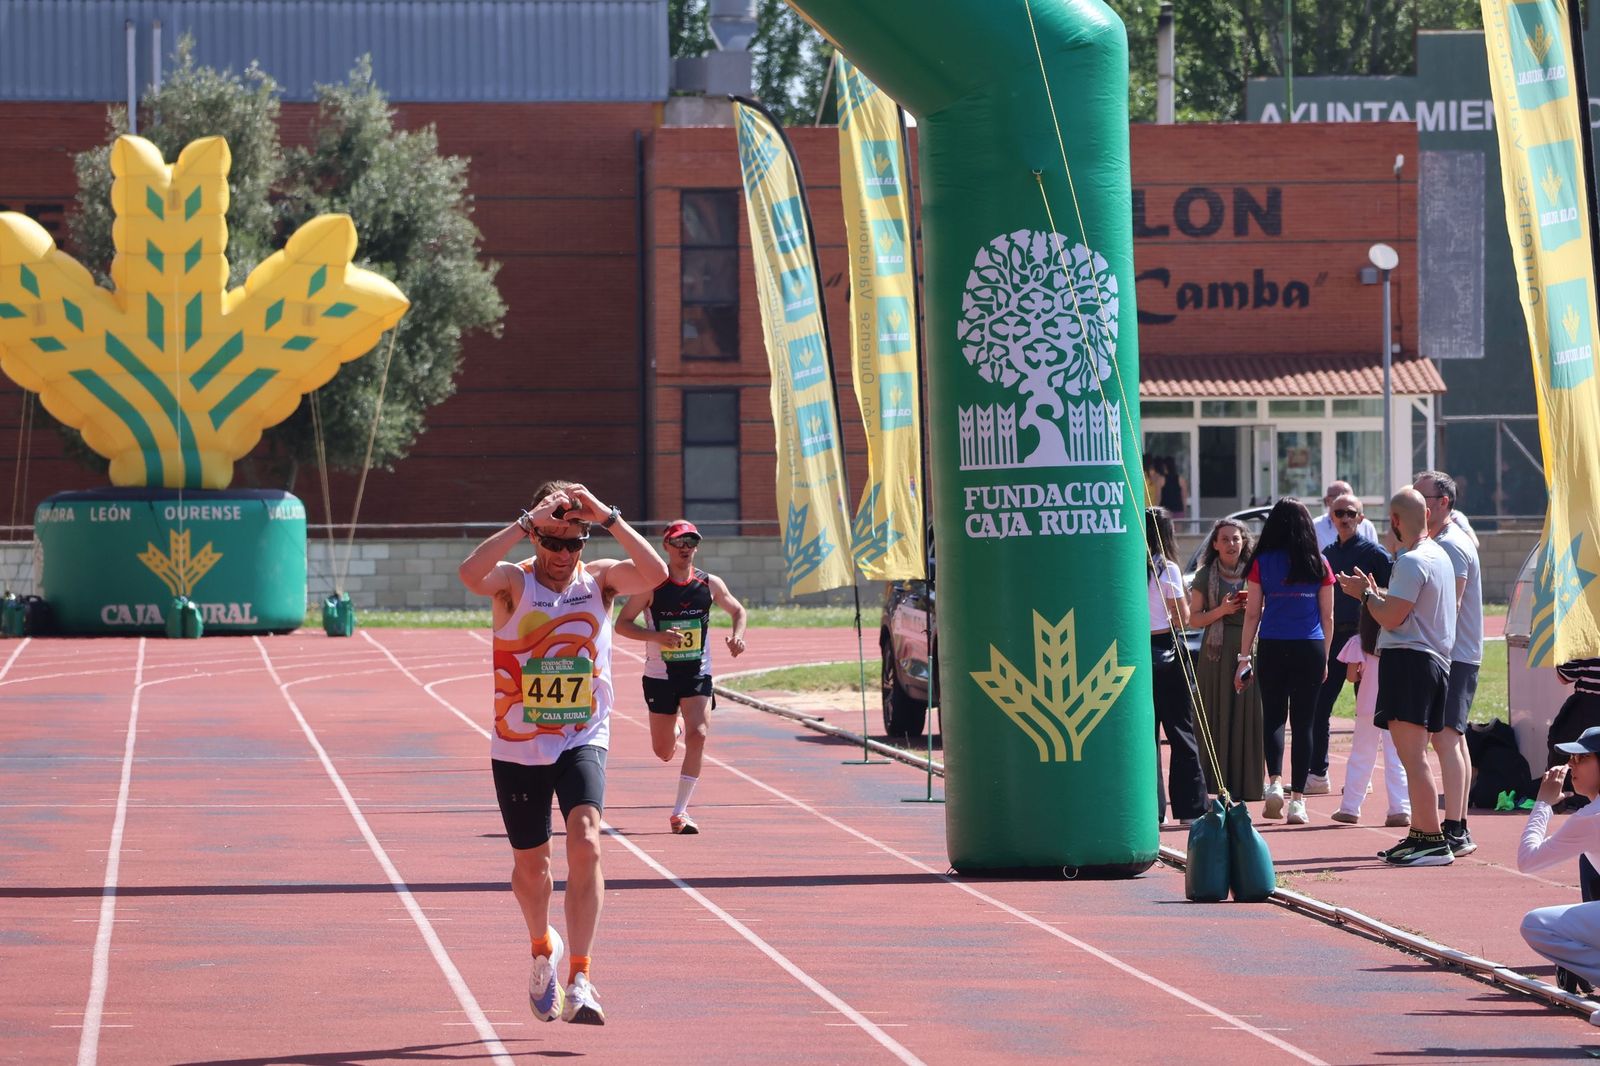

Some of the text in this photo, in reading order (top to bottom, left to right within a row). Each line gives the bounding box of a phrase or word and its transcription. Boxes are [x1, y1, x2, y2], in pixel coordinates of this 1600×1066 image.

[964, 481, 1125, 511] FUNDACION
[90, 504, 131, 522] LEÓN
[164, 505, 241, 521] OURENSE
[965, 509, 1127, 539] CAJA RURAL
[101, 602, 258, 626] CAJA URAL
[528, 677, 584, 703] 447
[563, 711, 588, 720] RURAL
